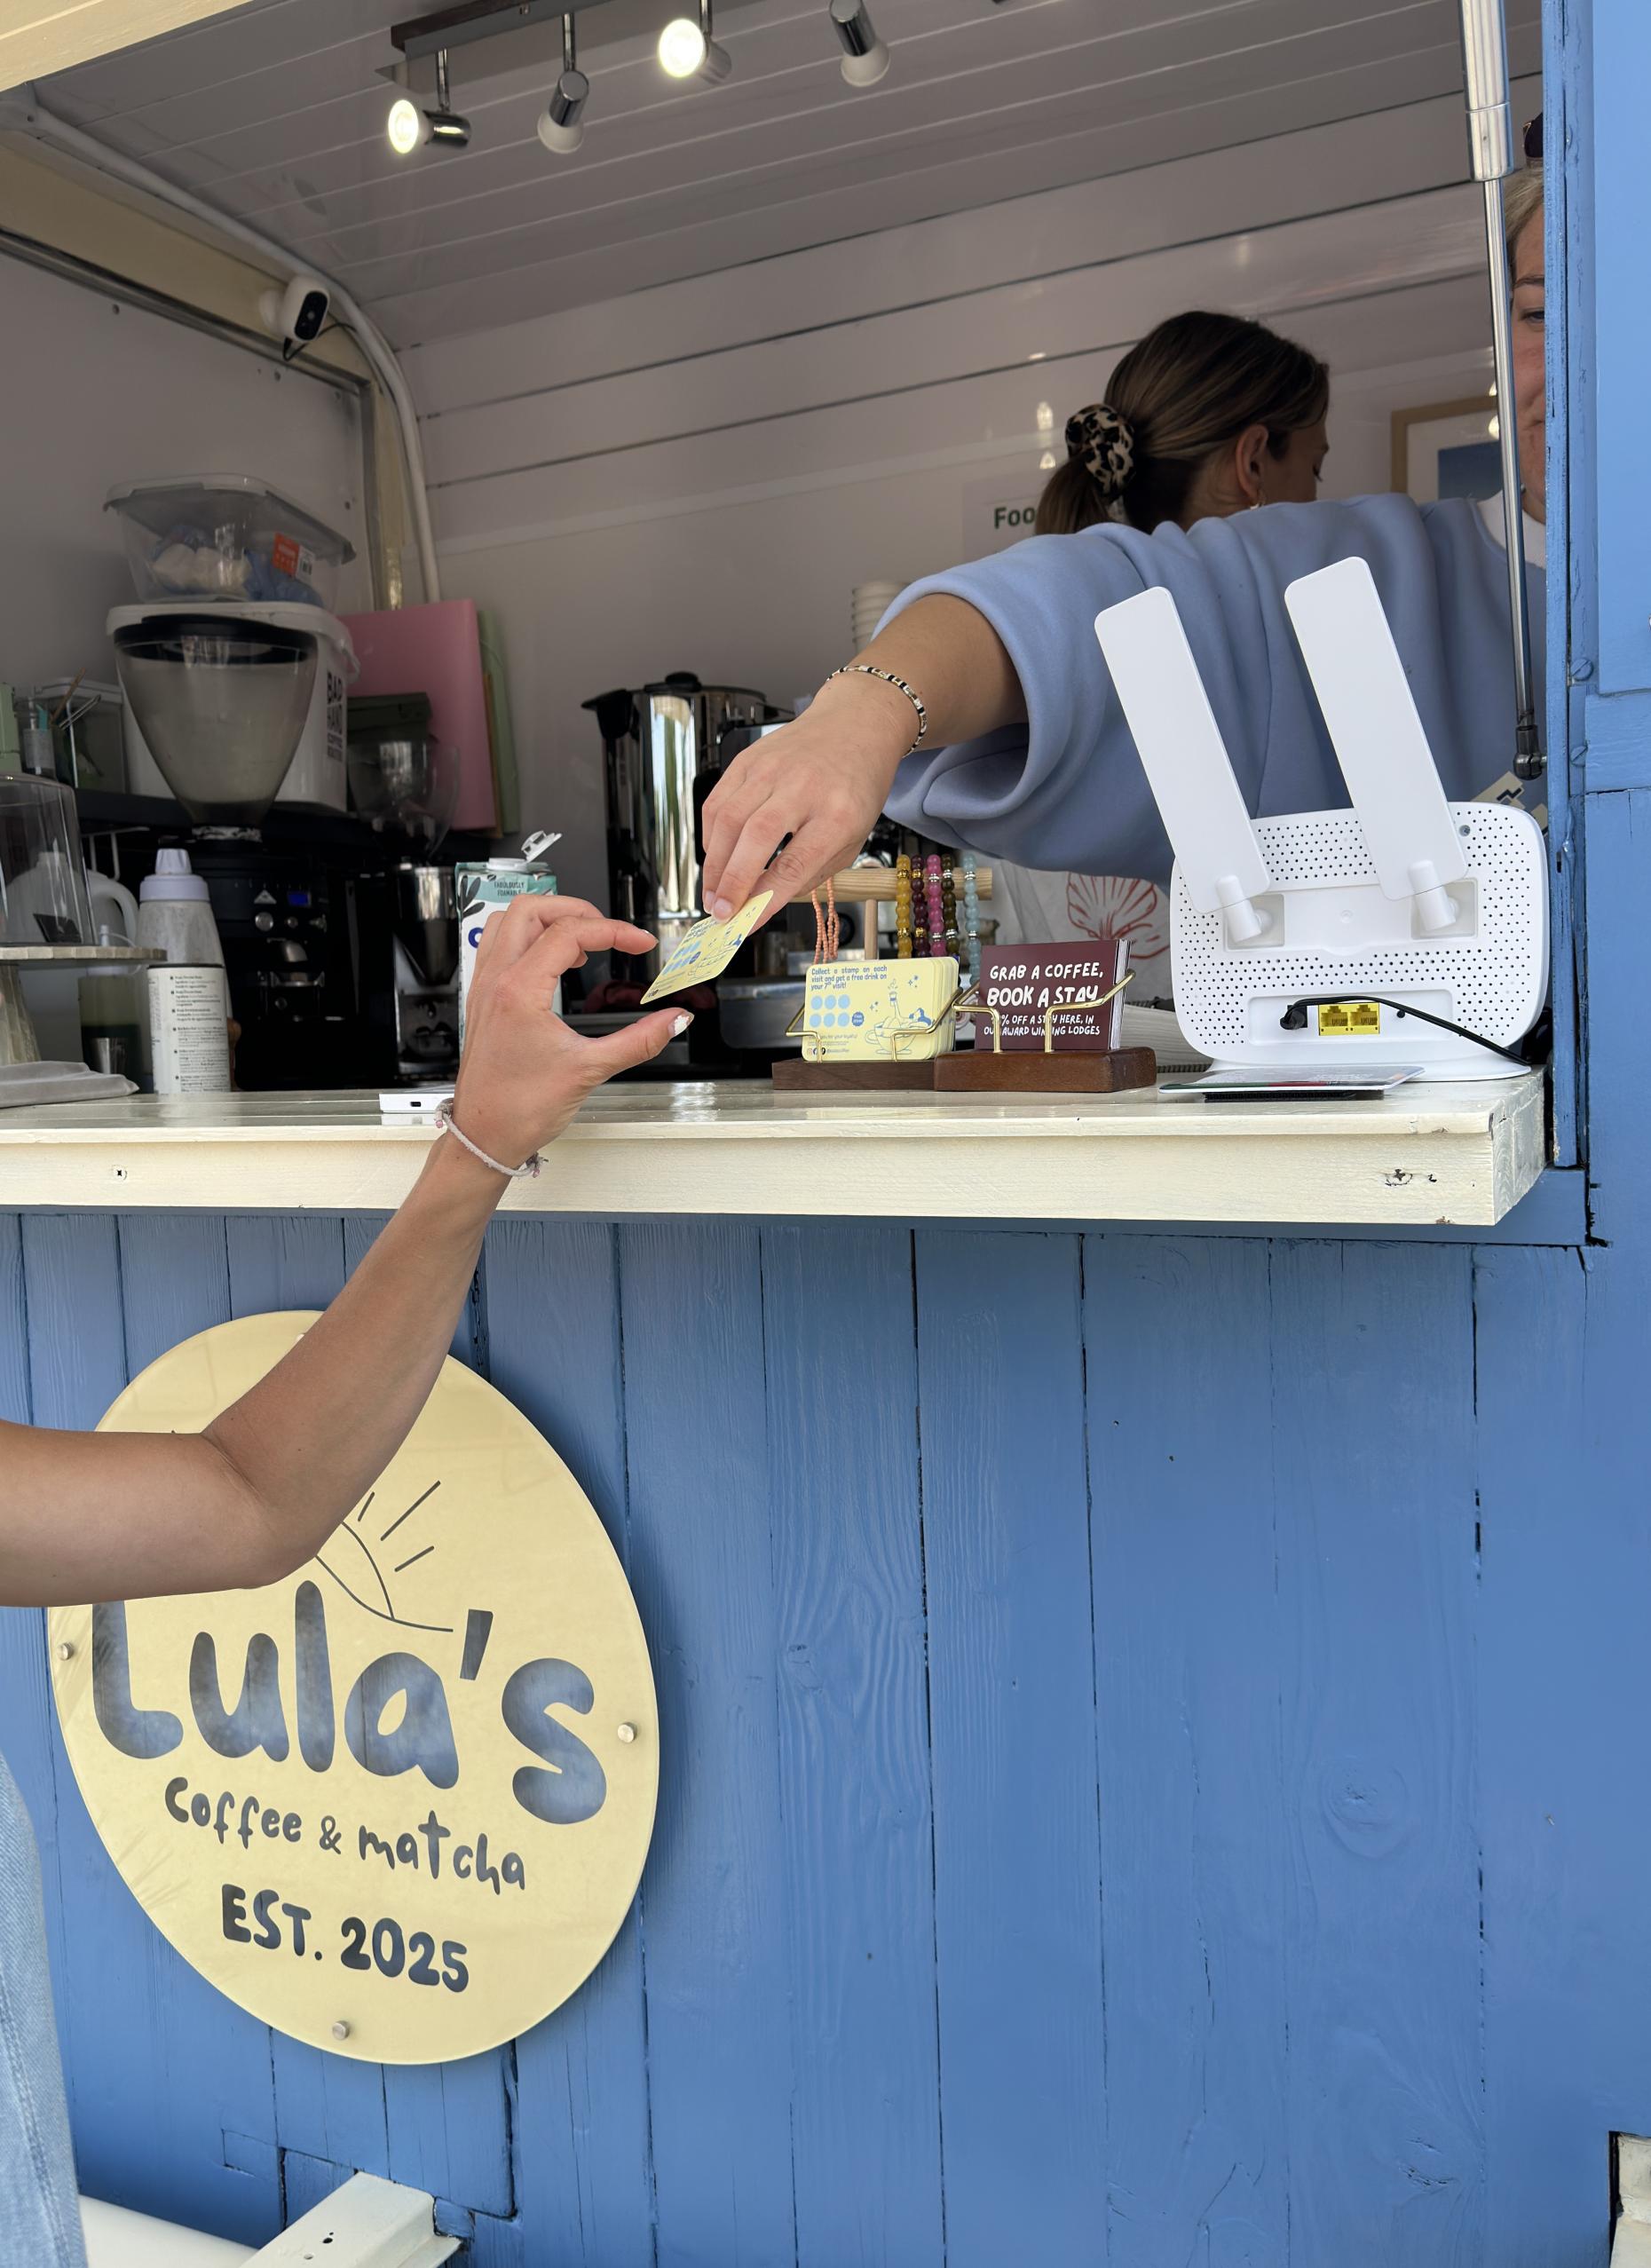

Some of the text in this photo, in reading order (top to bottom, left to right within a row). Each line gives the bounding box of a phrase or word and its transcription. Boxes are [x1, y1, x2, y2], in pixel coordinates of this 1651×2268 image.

[990, 962, 1103, 981] GRAB A COFFEE,
[986, 984, 1099, 1008] BOOK A STAY
[983, 1025, 1101, 1037] OU AWARD WINING LODGES
[1012, 1015, 1028, 1024] OFF
[1030, 1015, 1036, 1024] A
[1037, 1014, 1058, 1024] STY
[1059, 1014, 1083, 1024] HERE,
[1085, 1015, 1094, 1024] IN
[91, 1580, 607, 1825] Lula's
[165, 1777, 525, 1895] Coffee & matcha
[222, 1884, 470, 1993] EST. 2025
